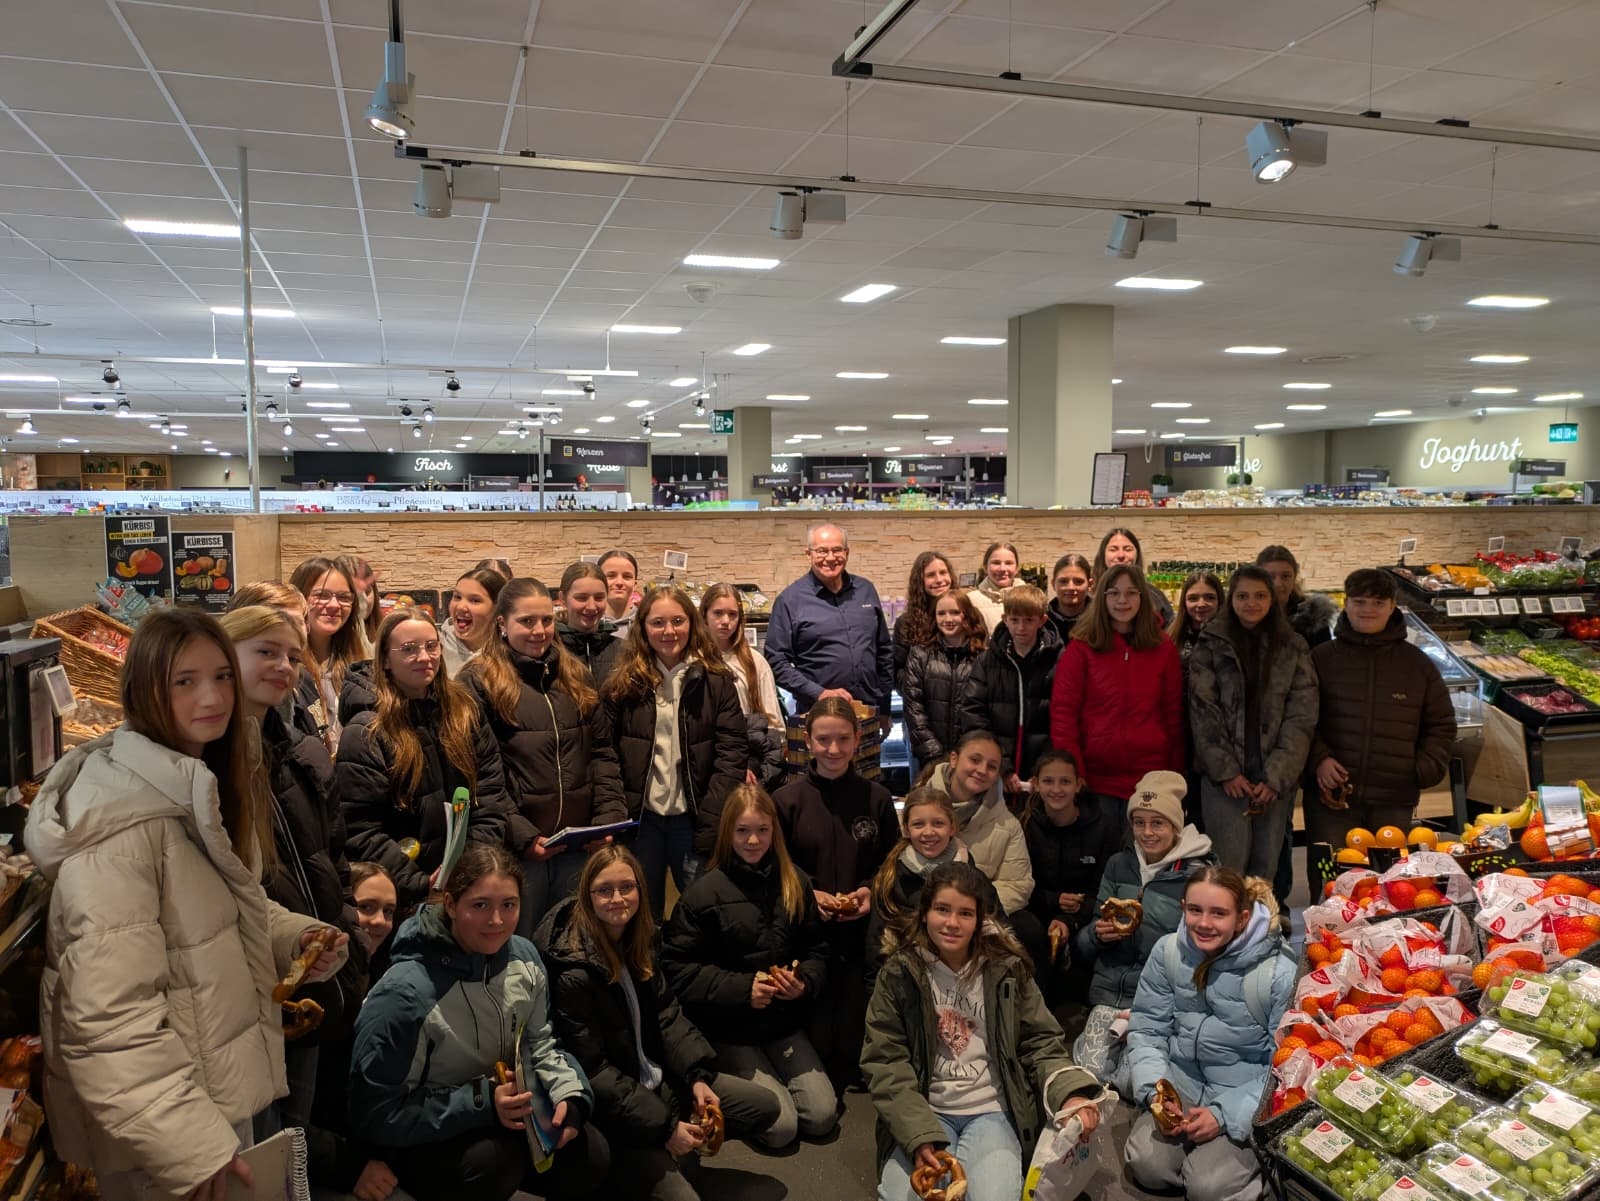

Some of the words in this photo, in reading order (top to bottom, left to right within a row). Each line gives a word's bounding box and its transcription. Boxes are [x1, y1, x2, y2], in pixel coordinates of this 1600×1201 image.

[1420, 437, 1523, 473] Joghurt
[414, 457, 453, 472] Fisch
[186, 536, 222, 546] KÜRBISSE
